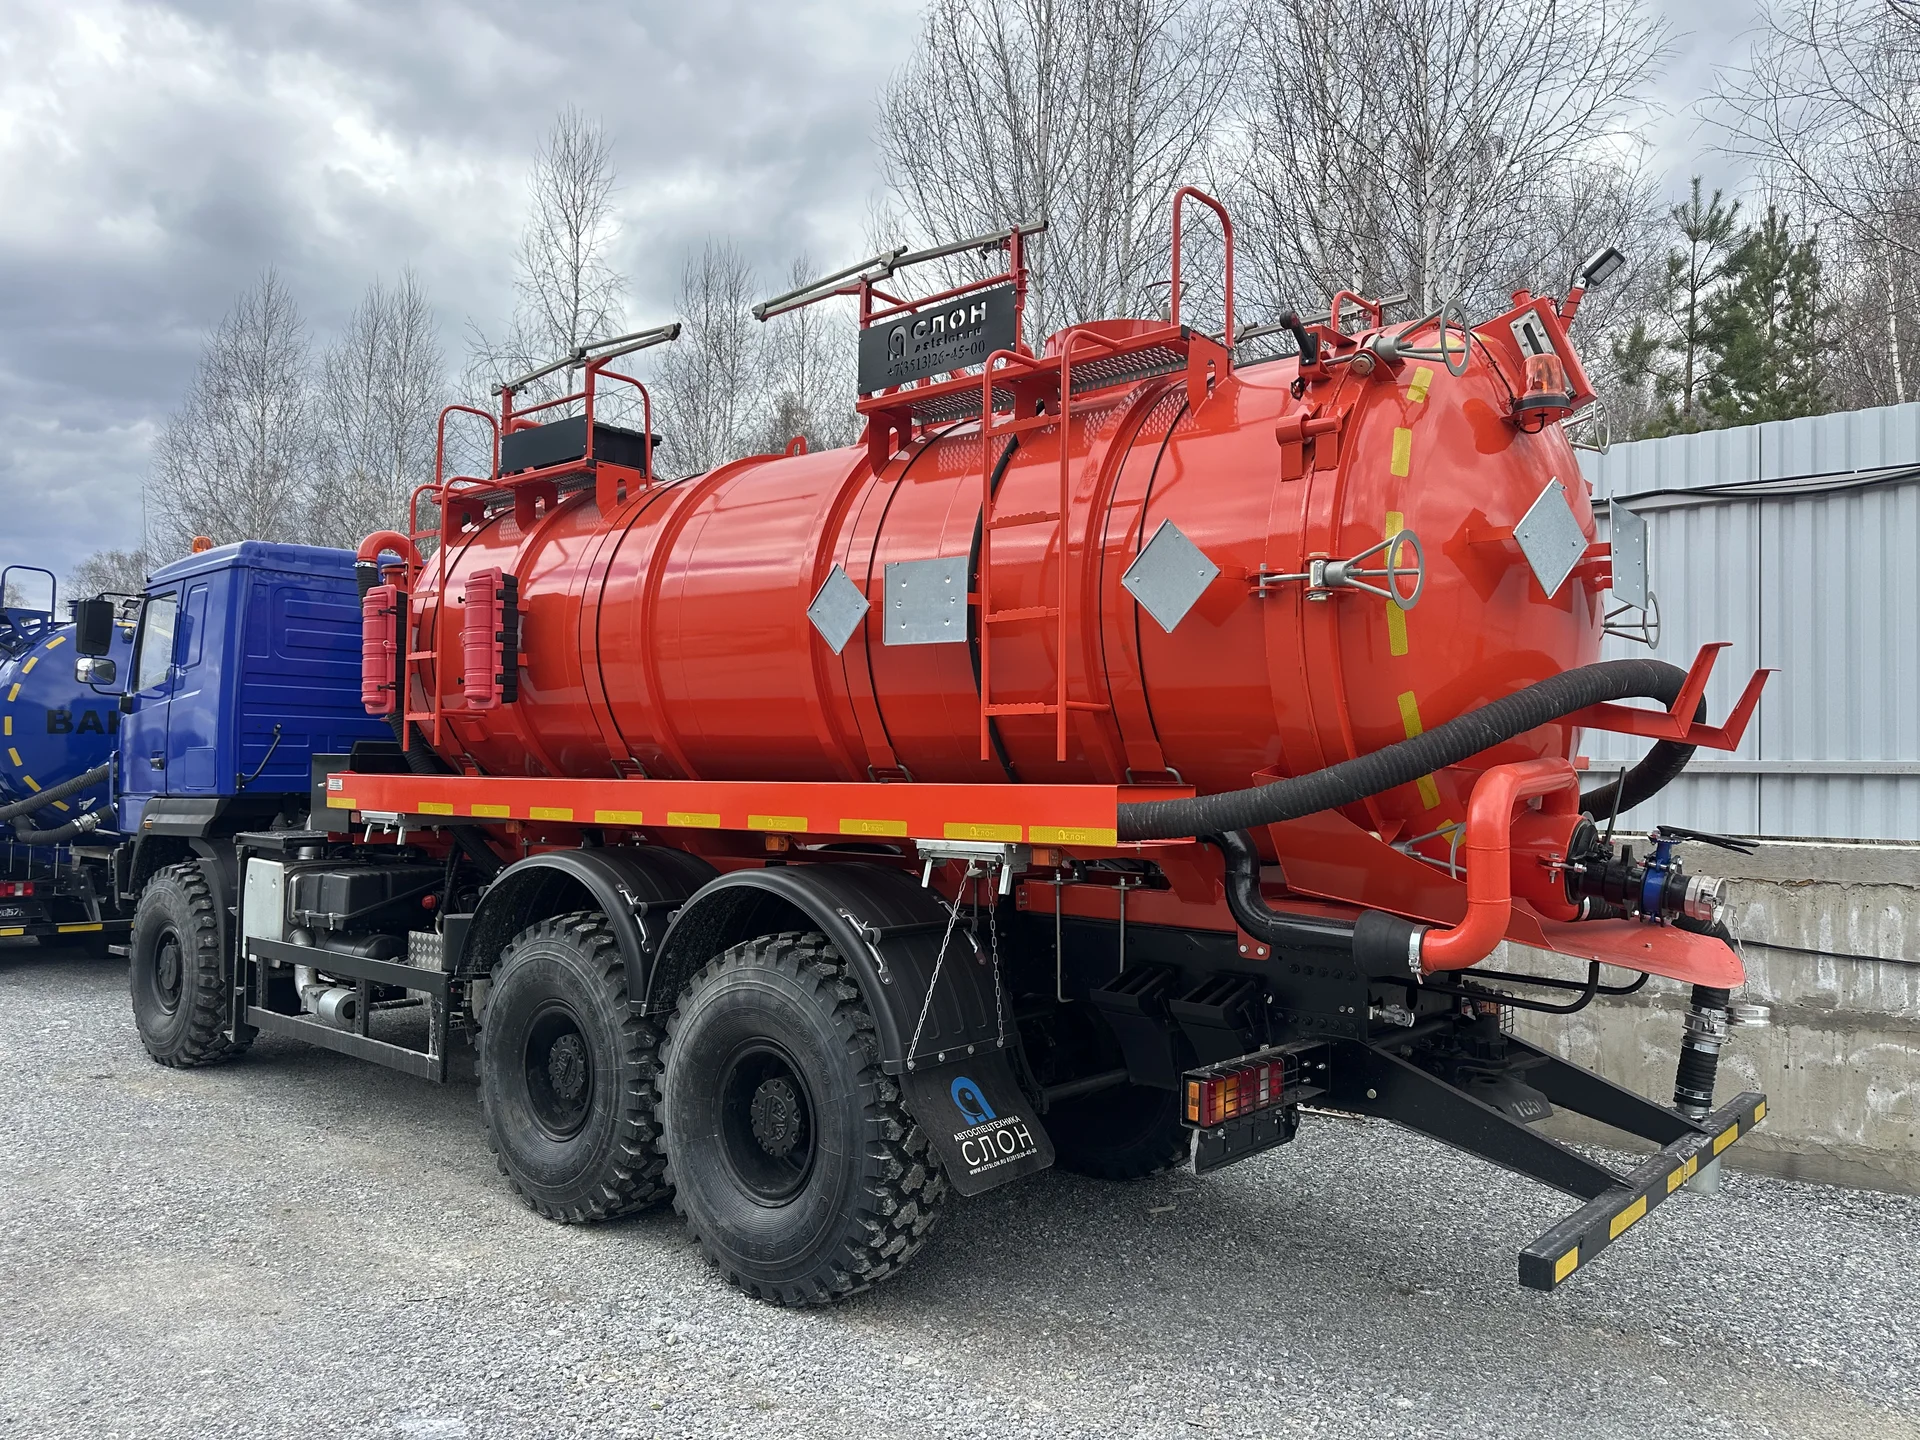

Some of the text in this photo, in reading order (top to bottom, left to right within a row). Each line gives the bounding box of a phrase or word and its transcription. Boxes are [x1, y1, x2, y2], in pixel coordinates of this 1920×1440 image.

[910, 301, 987, 340] СЛОН
[1065, 833, 1086, 841] СЛОН
[953, 1115, 1022, 1142] АВТОСПЕЦТЕХНИКА
[961, 1123, 1034, 1166] СЛОН
